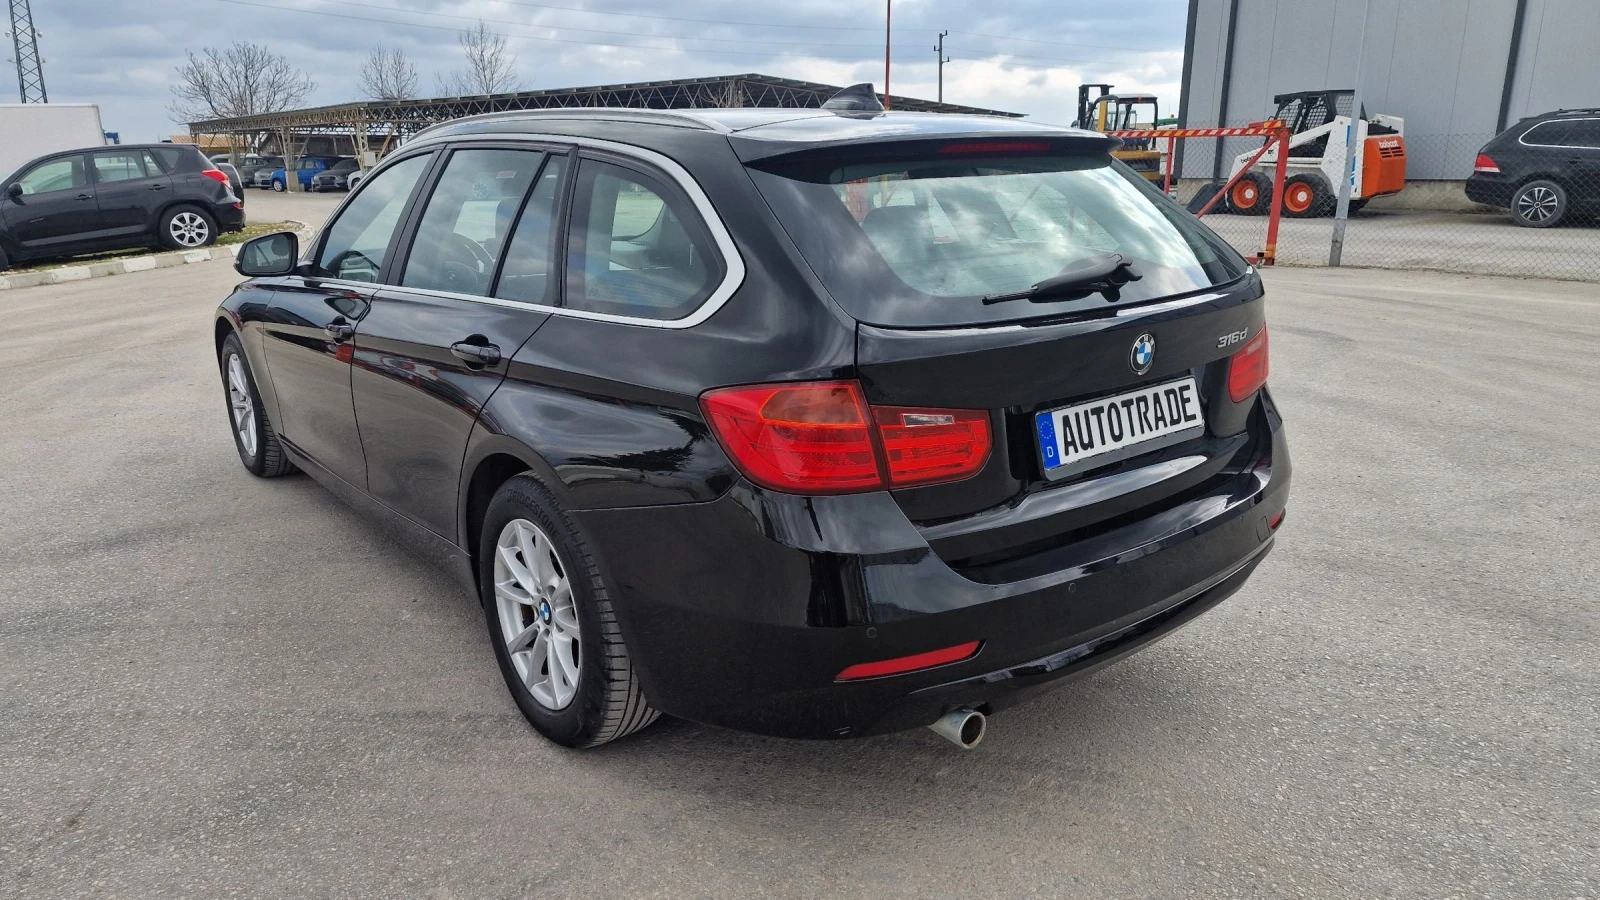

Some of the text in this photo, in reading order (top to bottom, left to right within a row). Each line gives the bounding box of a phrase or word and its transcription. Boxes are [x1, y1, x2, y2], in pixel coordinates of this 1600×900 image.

[1217, 327, 1248, 348] 316d
[1062, 384, 1197, 457] AUTOTRADE
[1046, 446, 1054, 458] D
[506, 488, 560, 541] BRIDGESTONE
